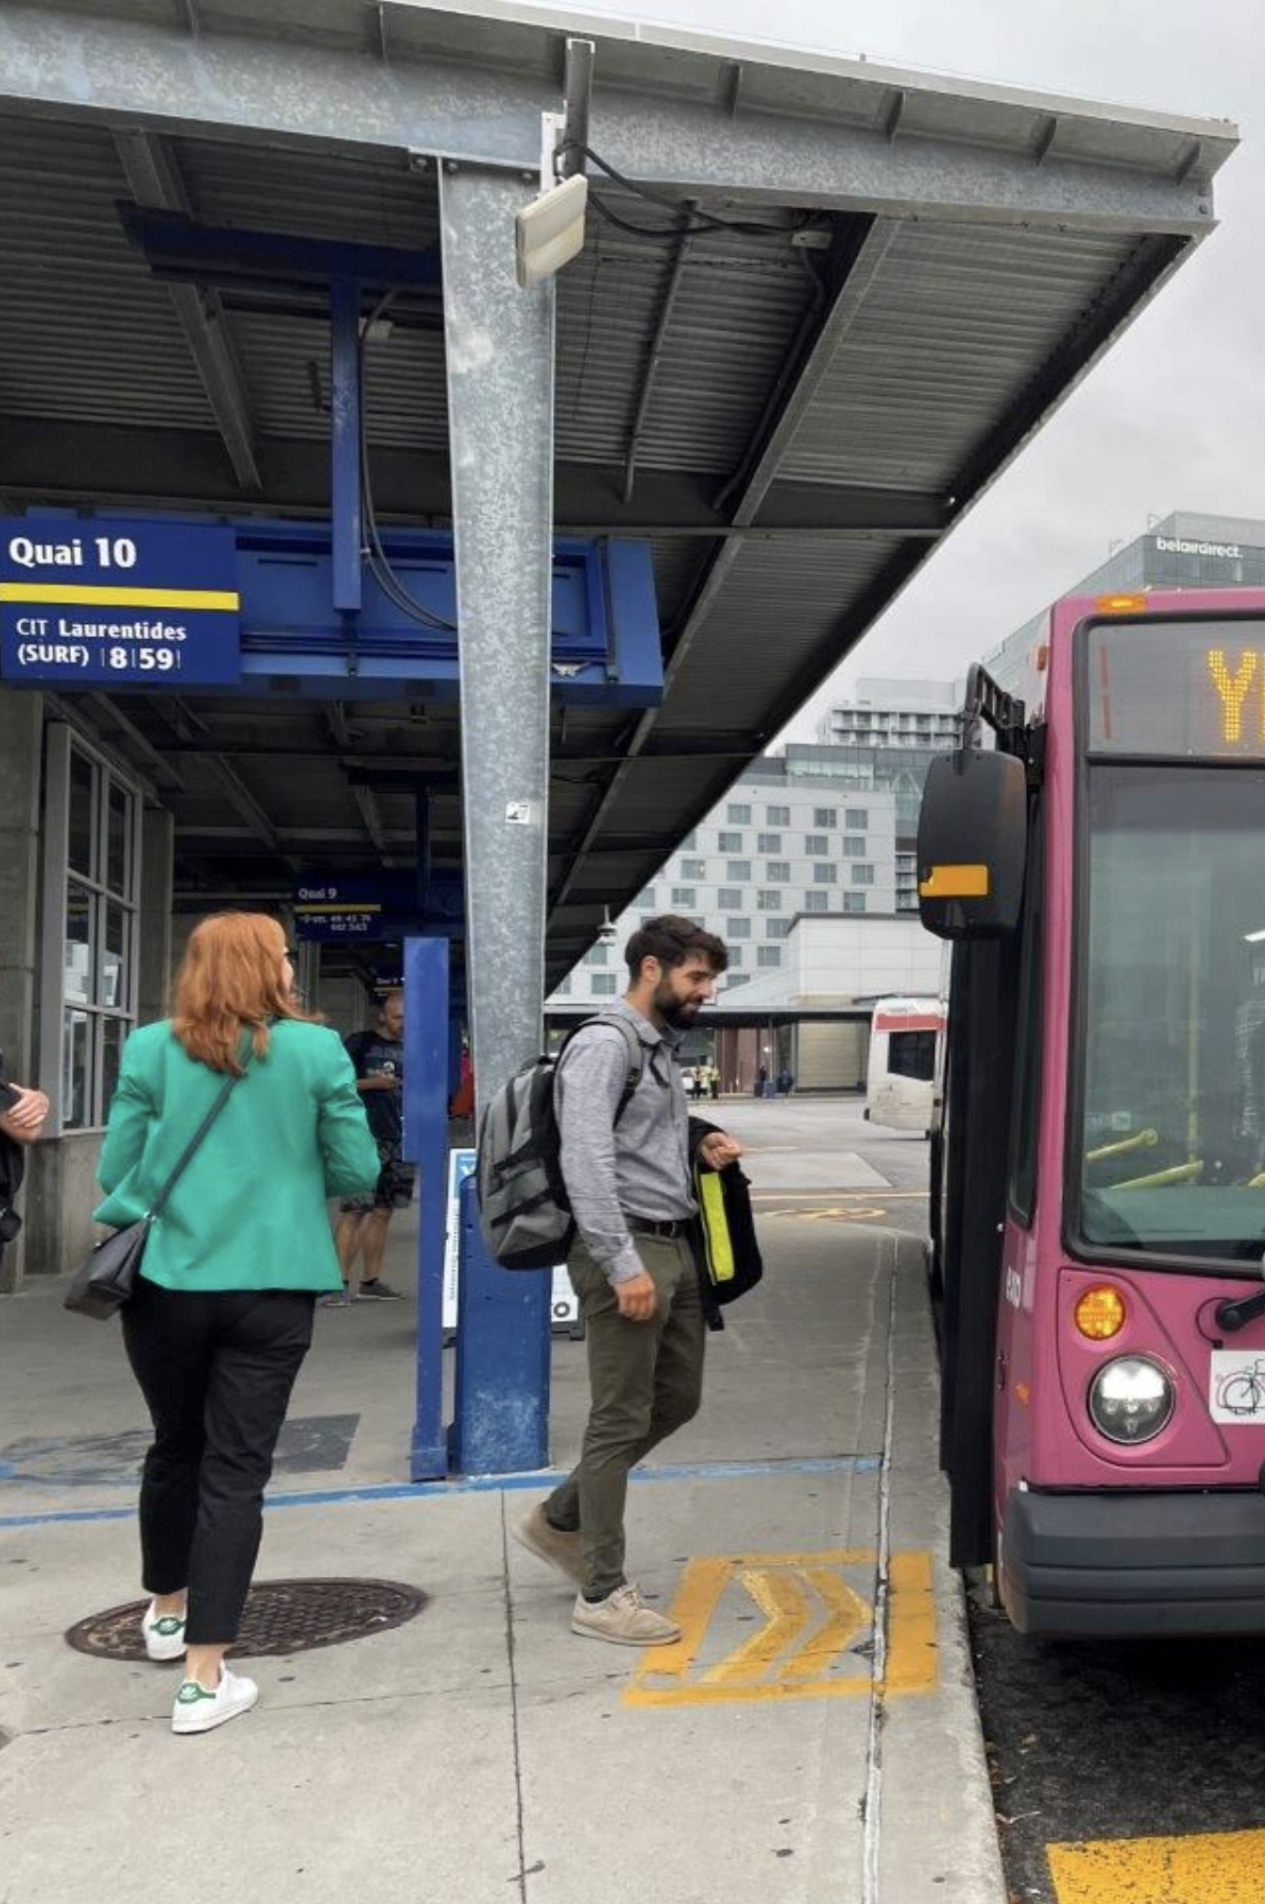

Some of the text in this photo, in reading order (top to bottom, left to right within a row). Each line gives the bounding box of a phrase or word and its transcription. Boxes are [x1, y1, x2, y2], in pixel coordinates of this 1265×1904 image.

[9, 537, 137, 568] Quai 10
[16, 618, 187, 641] CIT Laurentides
[17, 643, 90, 667] (SURF)
[298, 887, 326, 901] Quai
